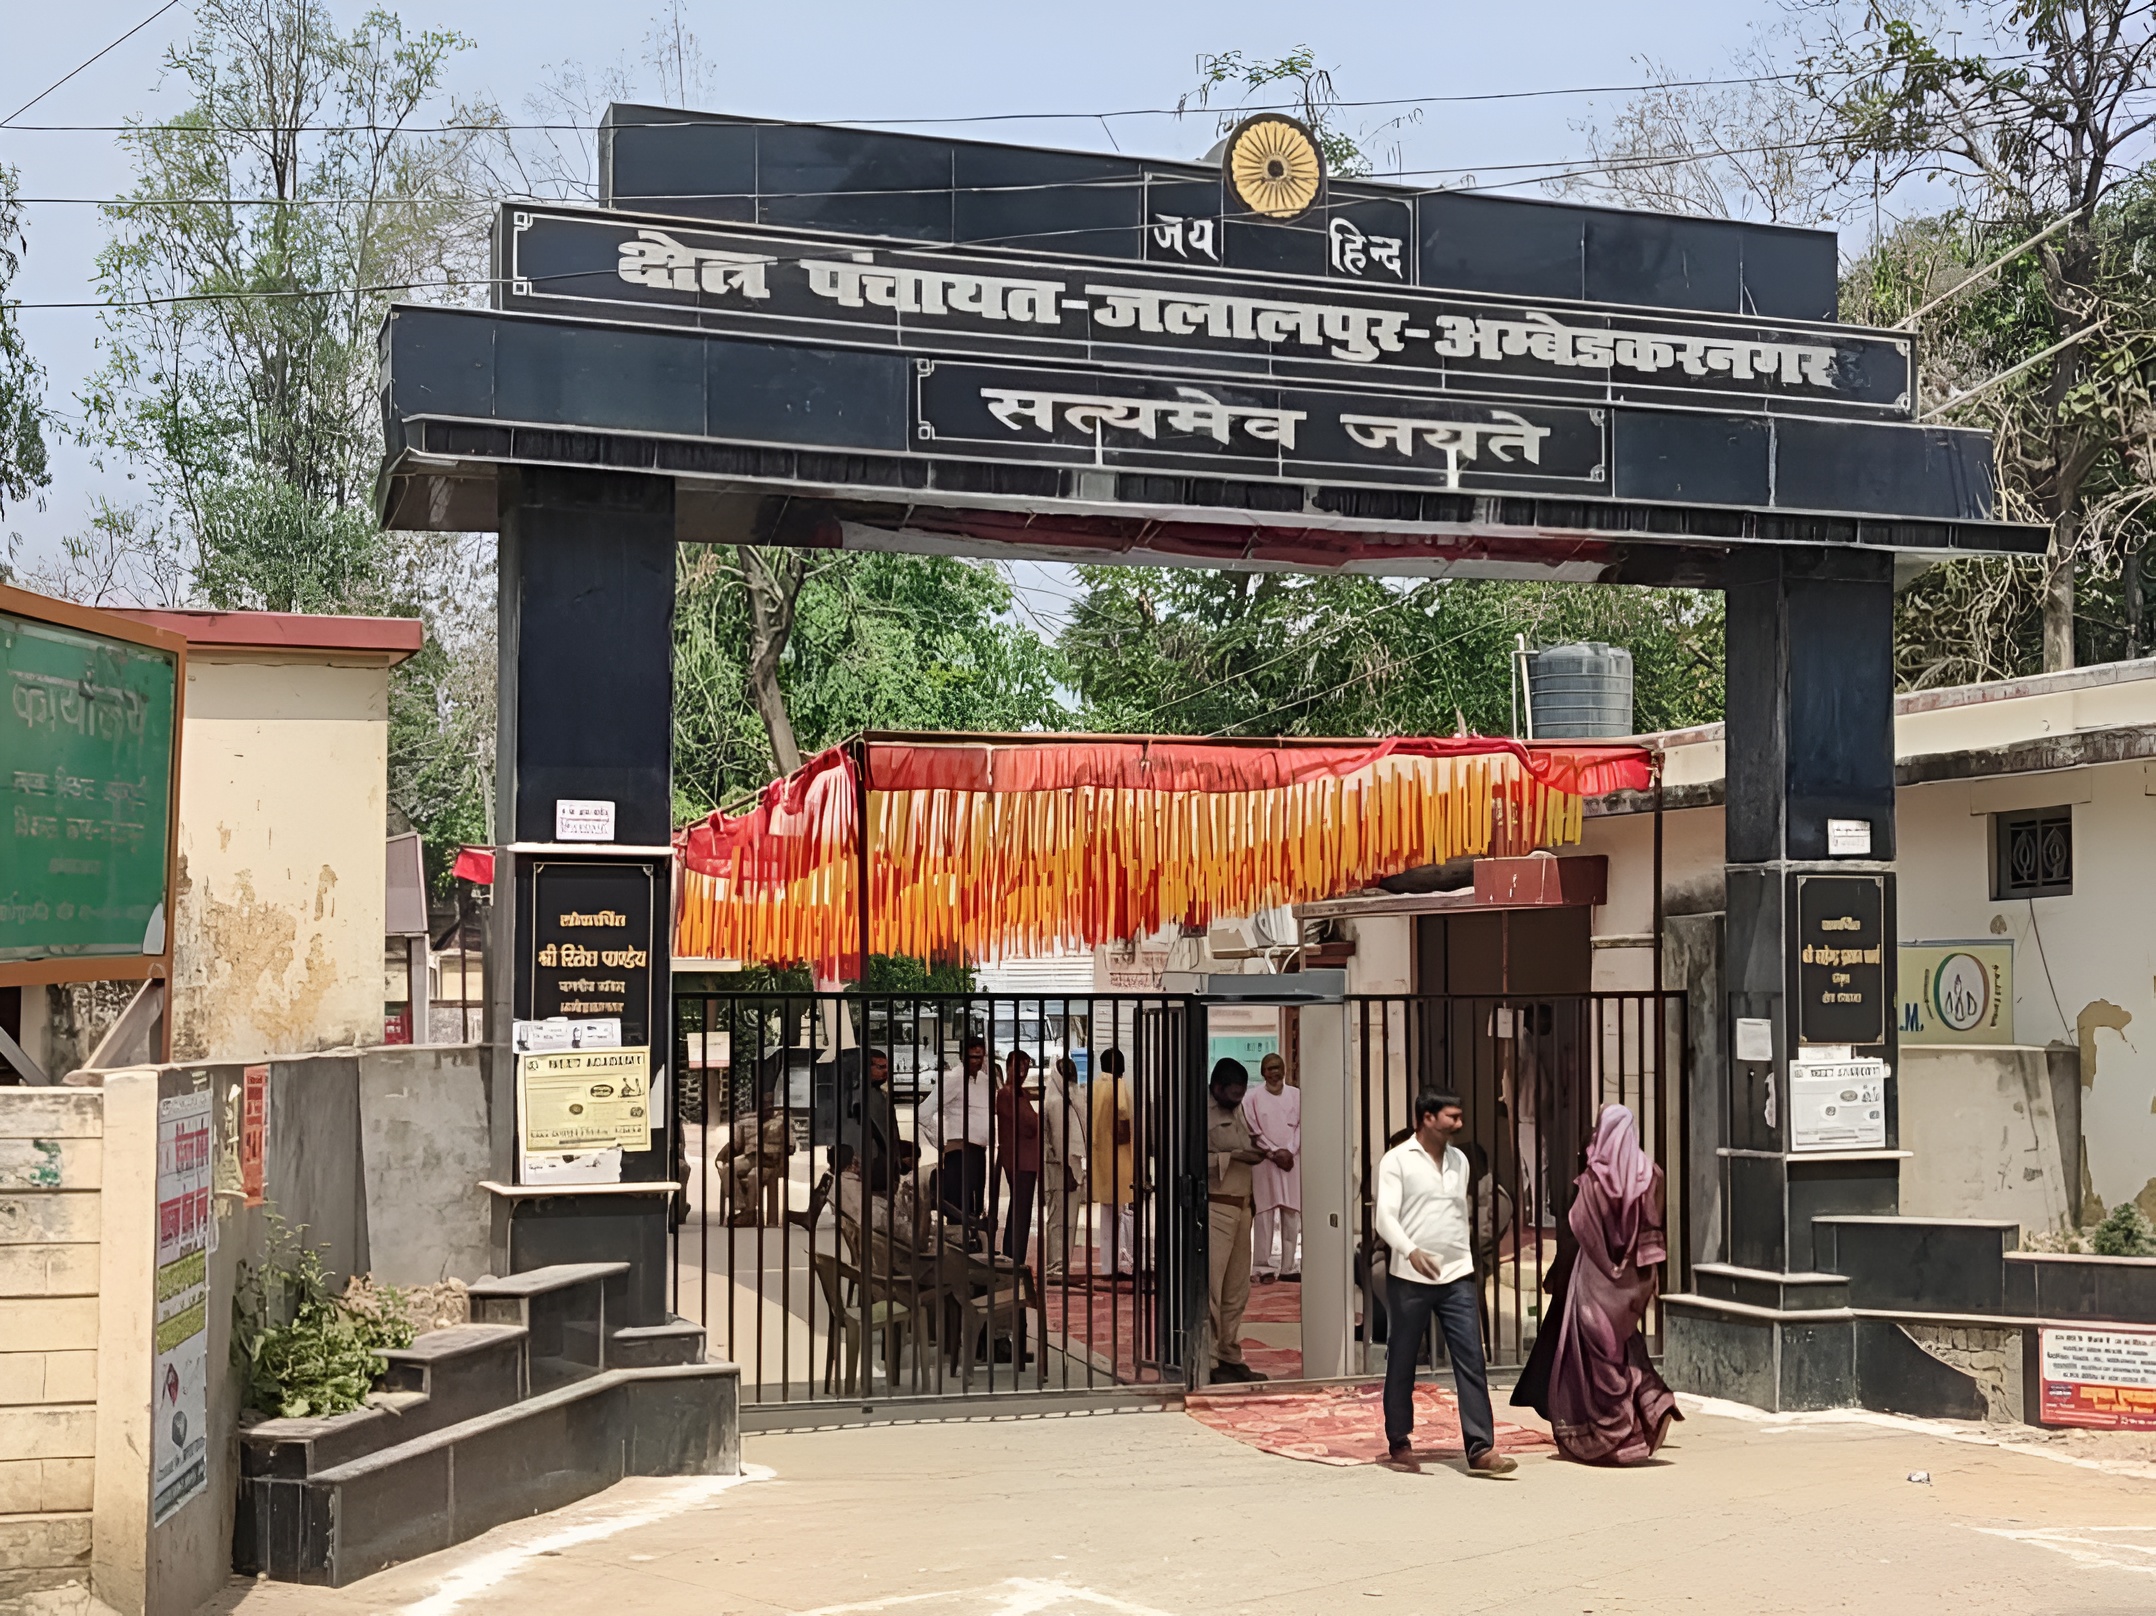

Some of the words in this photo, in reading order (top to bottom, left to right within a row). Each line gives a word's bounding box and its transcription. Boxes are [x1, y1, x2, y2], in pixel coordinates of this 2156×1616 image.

[1154, 212, 1221, 262] जय
[1328, 216, 1404, 279] हिन्द
[980, 386, 1308, 451] सत्यमेव
[1340, 410, 1552, 465] जयते
